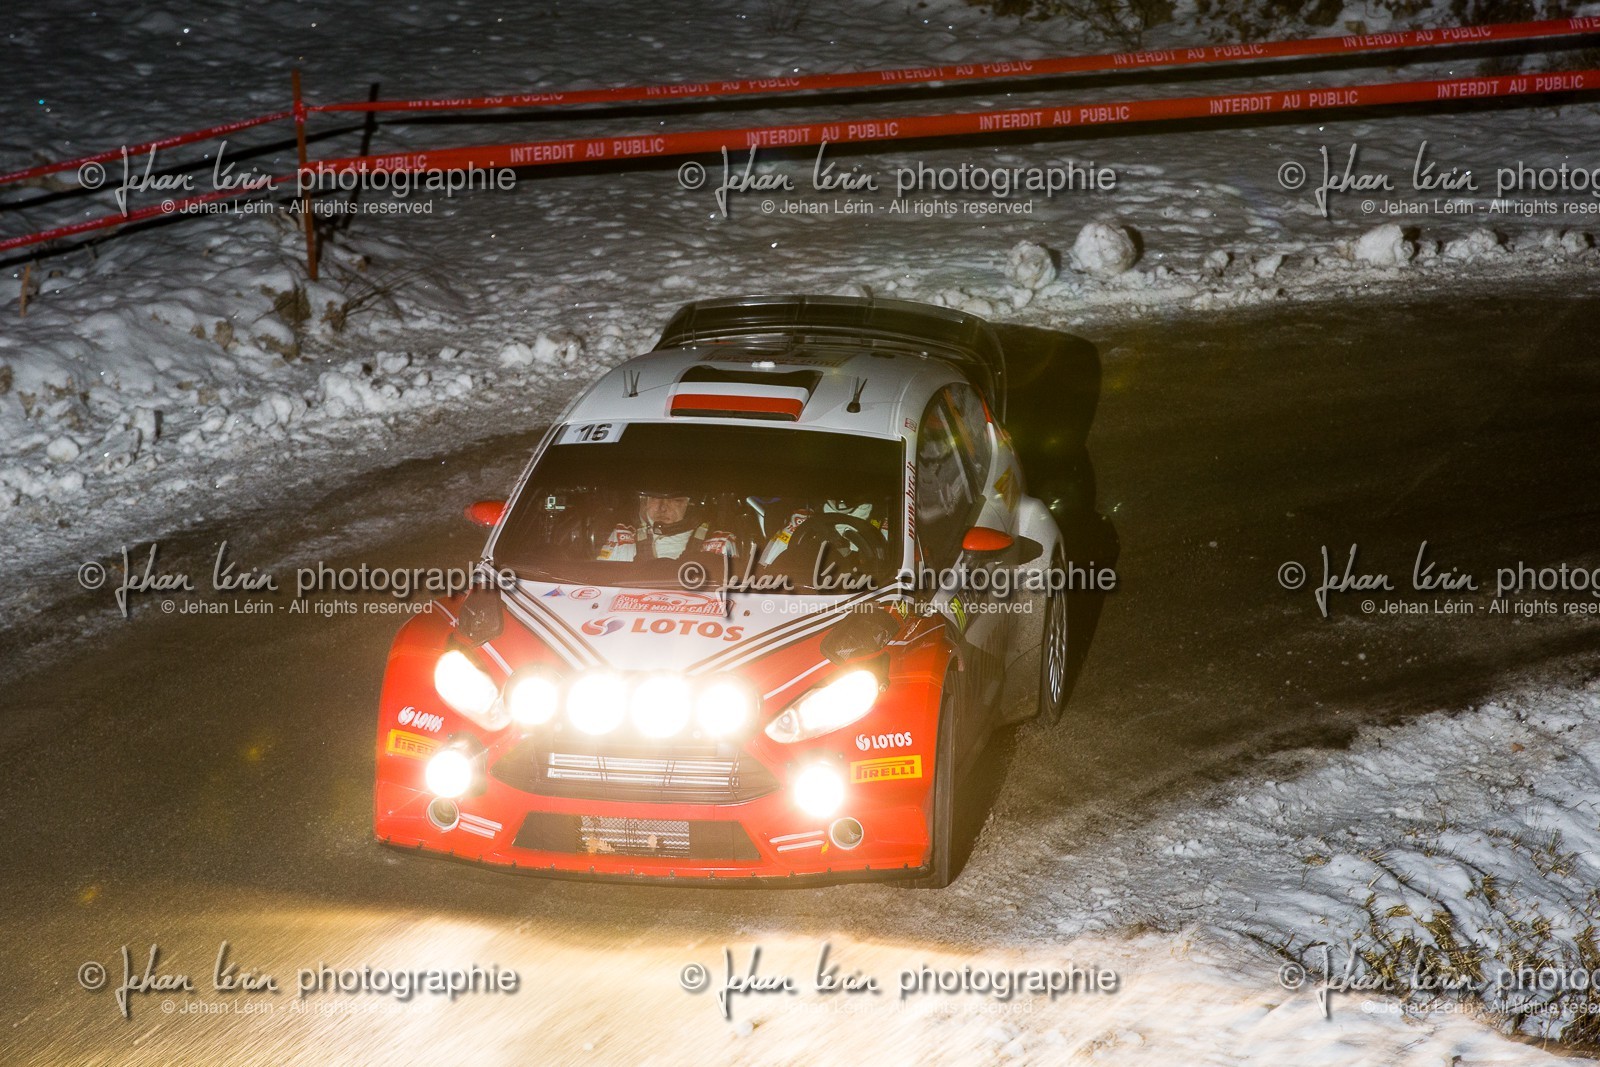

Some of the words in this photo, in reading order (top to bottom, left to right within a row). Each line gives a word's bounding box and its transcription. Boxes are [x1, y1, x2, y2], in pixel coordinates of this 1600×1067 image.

[1343, 32, 1406, 47] INTERDIT
[1416, 30, 1433, 42] AU
[1442, 26, 1492, 39] PUBLIC
[1437, 80, 1499, 98] INTERDIT
[1509, 79, 1527, 93] AU
[1536, 75, 1584, 91] PUBLIC
[1210, 96, 1272, 114] INTERDIT
[1282, 94, 1300, 109] AU
[1309, 90, 1358, 107] PUBLIC
[979, 112, 1042, 130] INTERDIT
[1053, 109, 1071, 125] AU
[1080, 106, 1130, 123] PUBLIC
[746, 128, 810, 146] INTERDIT
[821, 125, 840, 141] AU
[848, 122, 899, 139] PUBLIC
[510, 144, 575, 163] INTERDIT
[586, 142, 604, 158] AU
[614, 138, 665, 155] PUBLIC
[375, 155, 427, 171] PUBLIC
[575, 423, 612, 441] 16
[615, 600, 650, 610] RALLYE
[631, 618, 744, 641] LOTOS
[411, 710, 445, 733] LOTOS
[871, 731, 913, 749] LOTOS
[856, 759, 915, 780] PIRELLI
